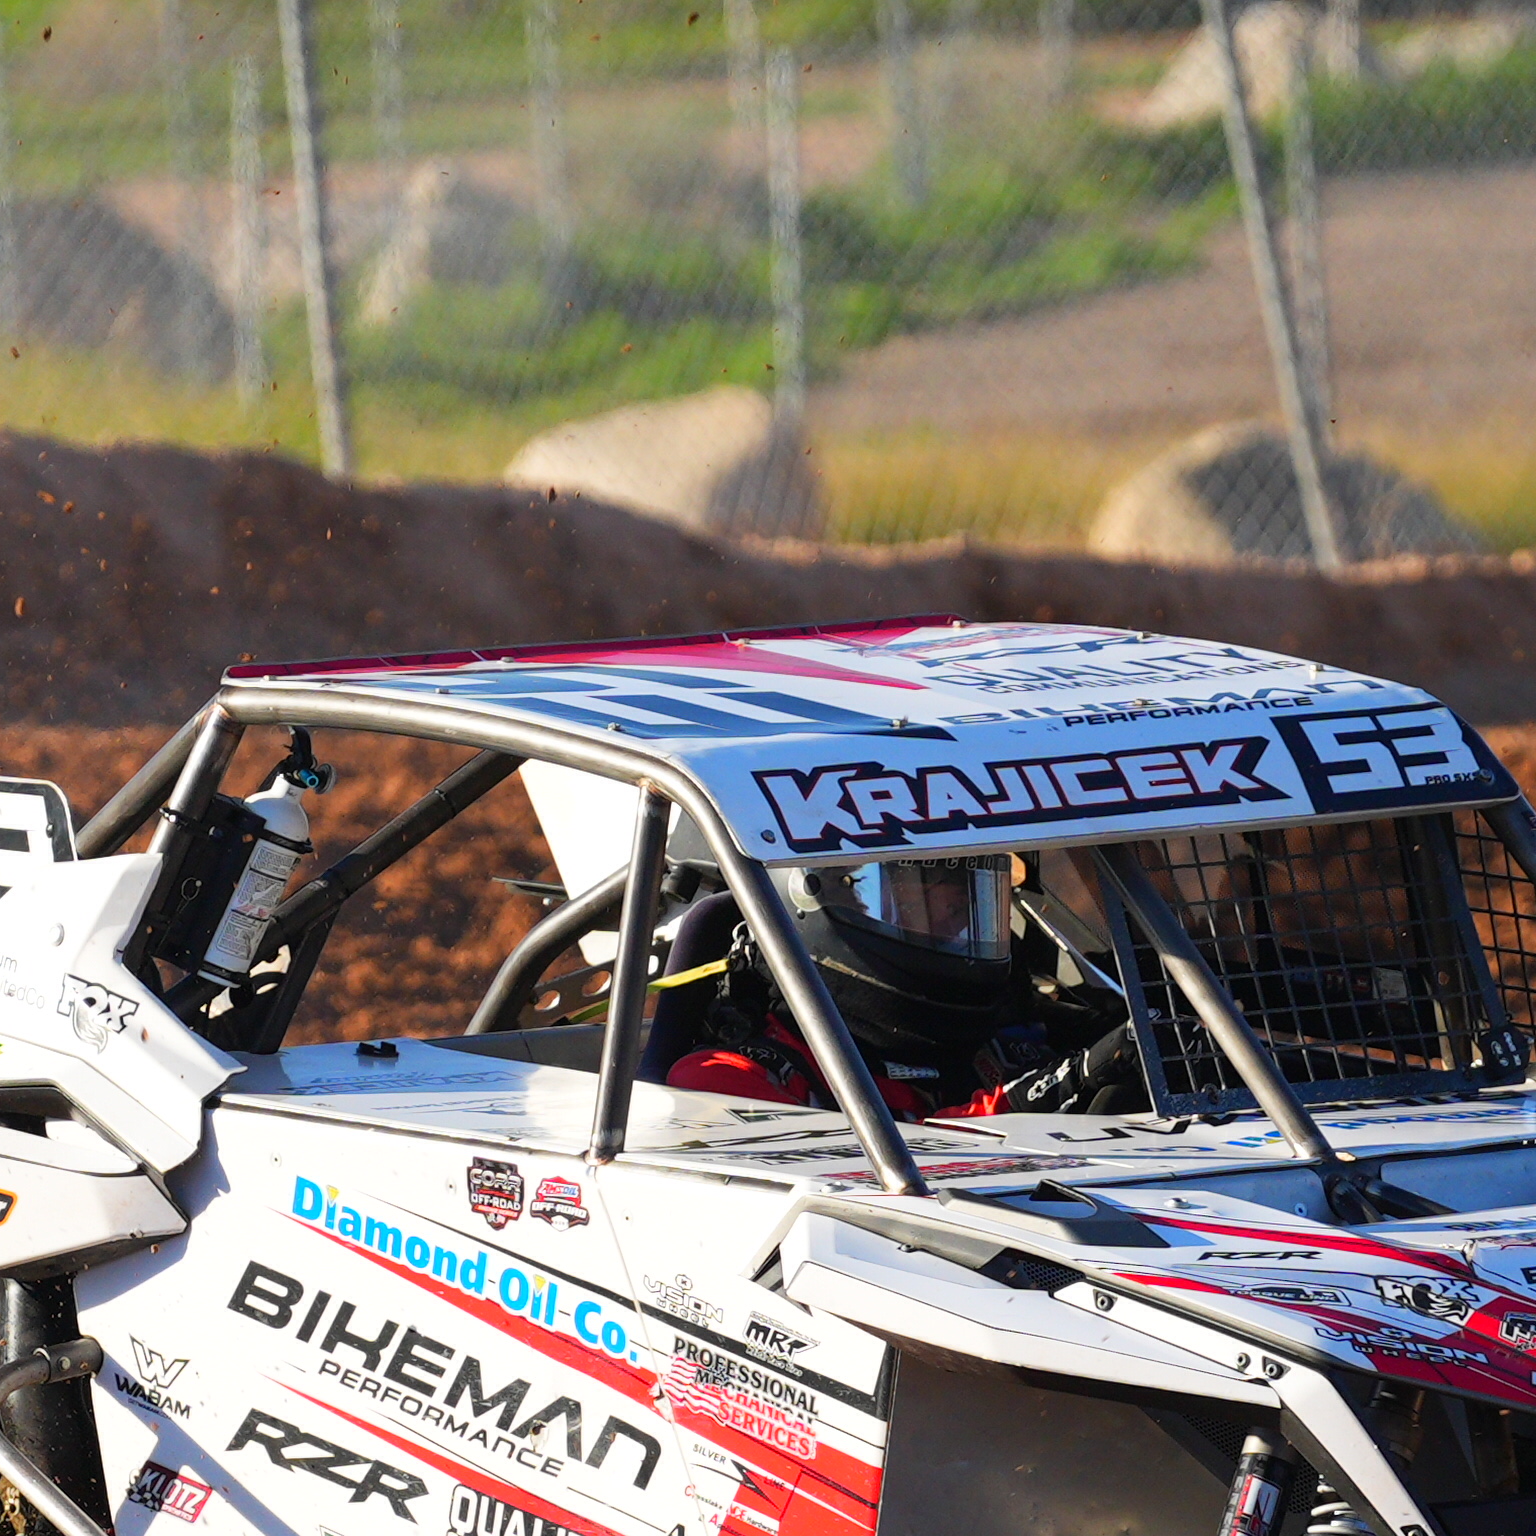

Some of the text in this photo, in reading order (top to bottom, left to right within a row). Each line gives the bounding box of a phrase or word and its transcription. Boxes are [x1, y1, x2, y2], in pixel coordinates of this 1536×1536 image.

[923, 648, 1264, 686] QUALITY
[976, 660, 1305, 694] COMMUNICATIONS
[937, 680, 1385, 725] BIKEMAN
[1065, 696, 1314, 727] PERFORMANCE
[756, 706, 1480, 850] KRAJICEK 53
[57, 973, 140, 1040] FOX
[291, 1176, 640, 1363] Diamond Oil Co.
[1197, 1251, 1321, 1261] RZR
[642, 1275, 724, 1323] VISION
[1301, 1289, 1338, 1302] LINK
[1374, 1275, 1480, 1320] FOX
[745, 1319, 810, 1357] MRT
[1314, 1327, 1490, 1365] VISION
[114, 1373, 192, 1420] WABAM
[227, 1260, 661, 1490] BIKEMAN
[674, 1335, 819, 1415] PROFESSIONAL
[318, 1359, 564, 1477] PERFORMANCE
[695, 1367, 816, 1437] MECHANICAL
[718, 1402, 810, 1457] SERVICES
[225, 1408, 429, 1524] RZR
[692, 1443, 727, 1465] SILVER
[134, 1468, 207, 1513] KLOTZ
